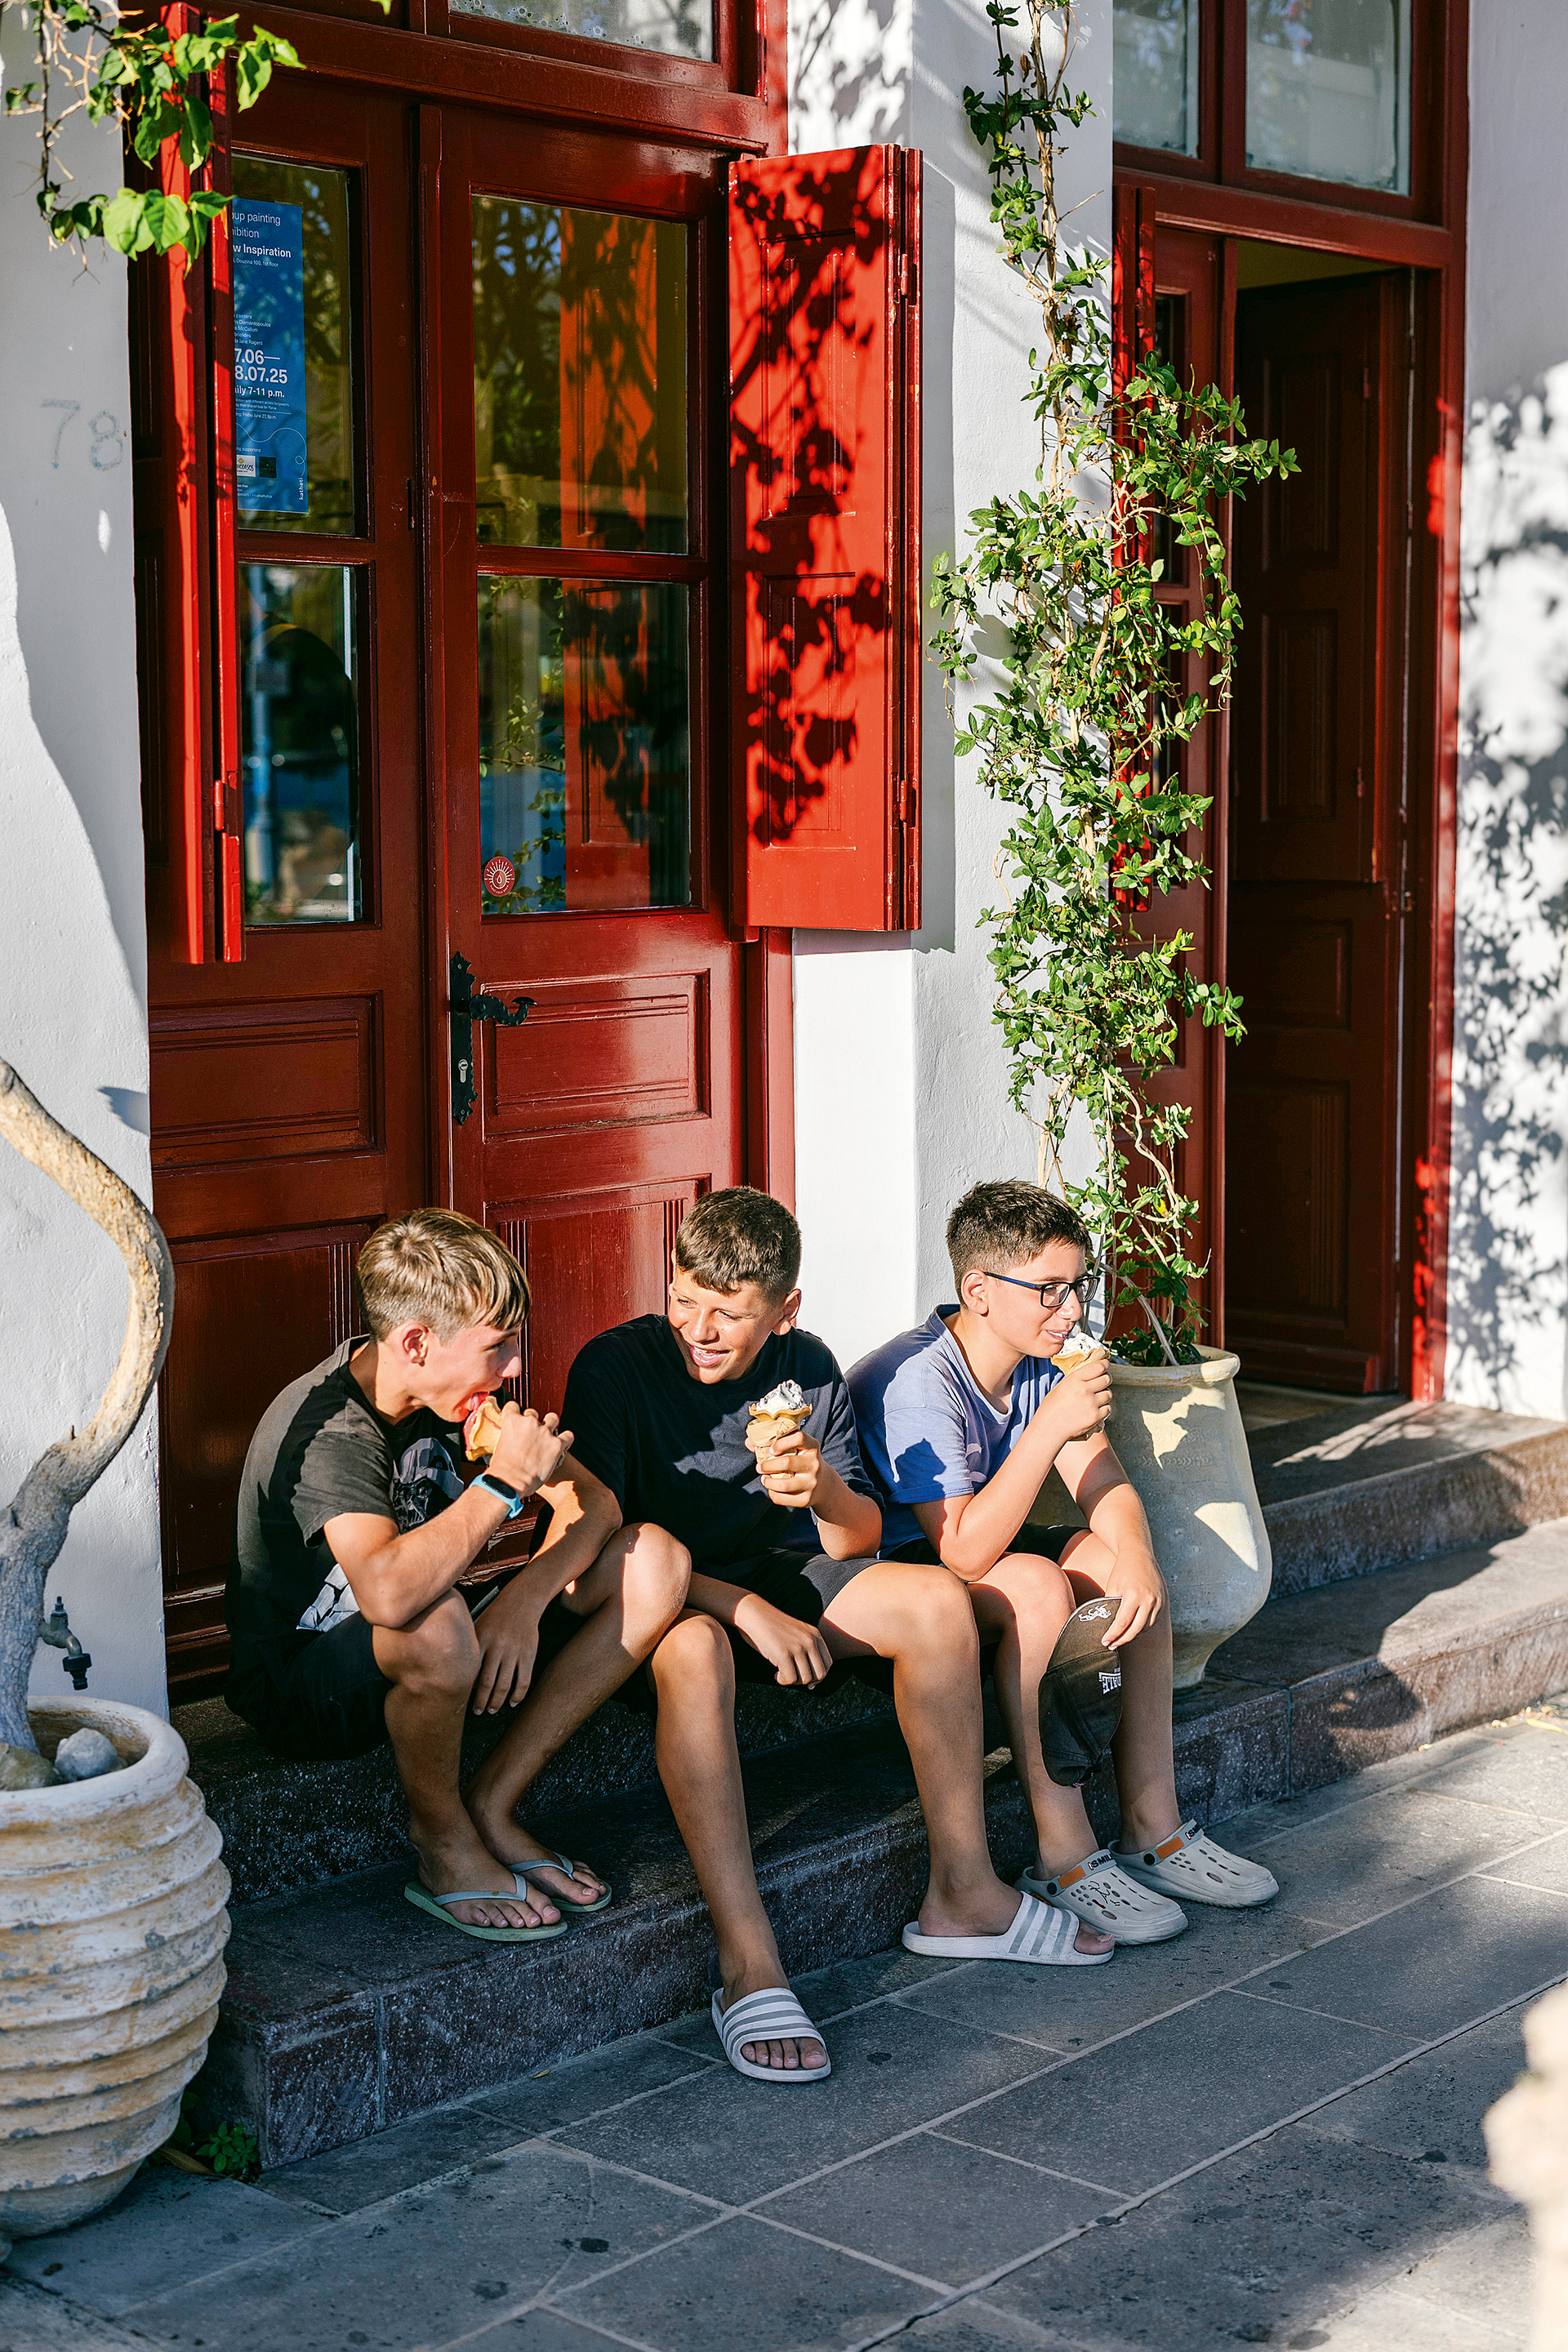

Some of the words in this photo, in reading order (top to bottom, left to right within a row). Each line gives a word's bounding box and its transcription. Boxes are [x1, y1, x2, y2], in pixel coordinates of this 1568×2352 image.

[247, 213, 281, 226] painting
[243, 243, 292, 258] Inspiration
[234, 365, 288, 384] 8.07.25
[247, 386, 265, 396] 7-11
[268, 390, 285, 399] p.m.
[41, 399, 123, 471] 78
